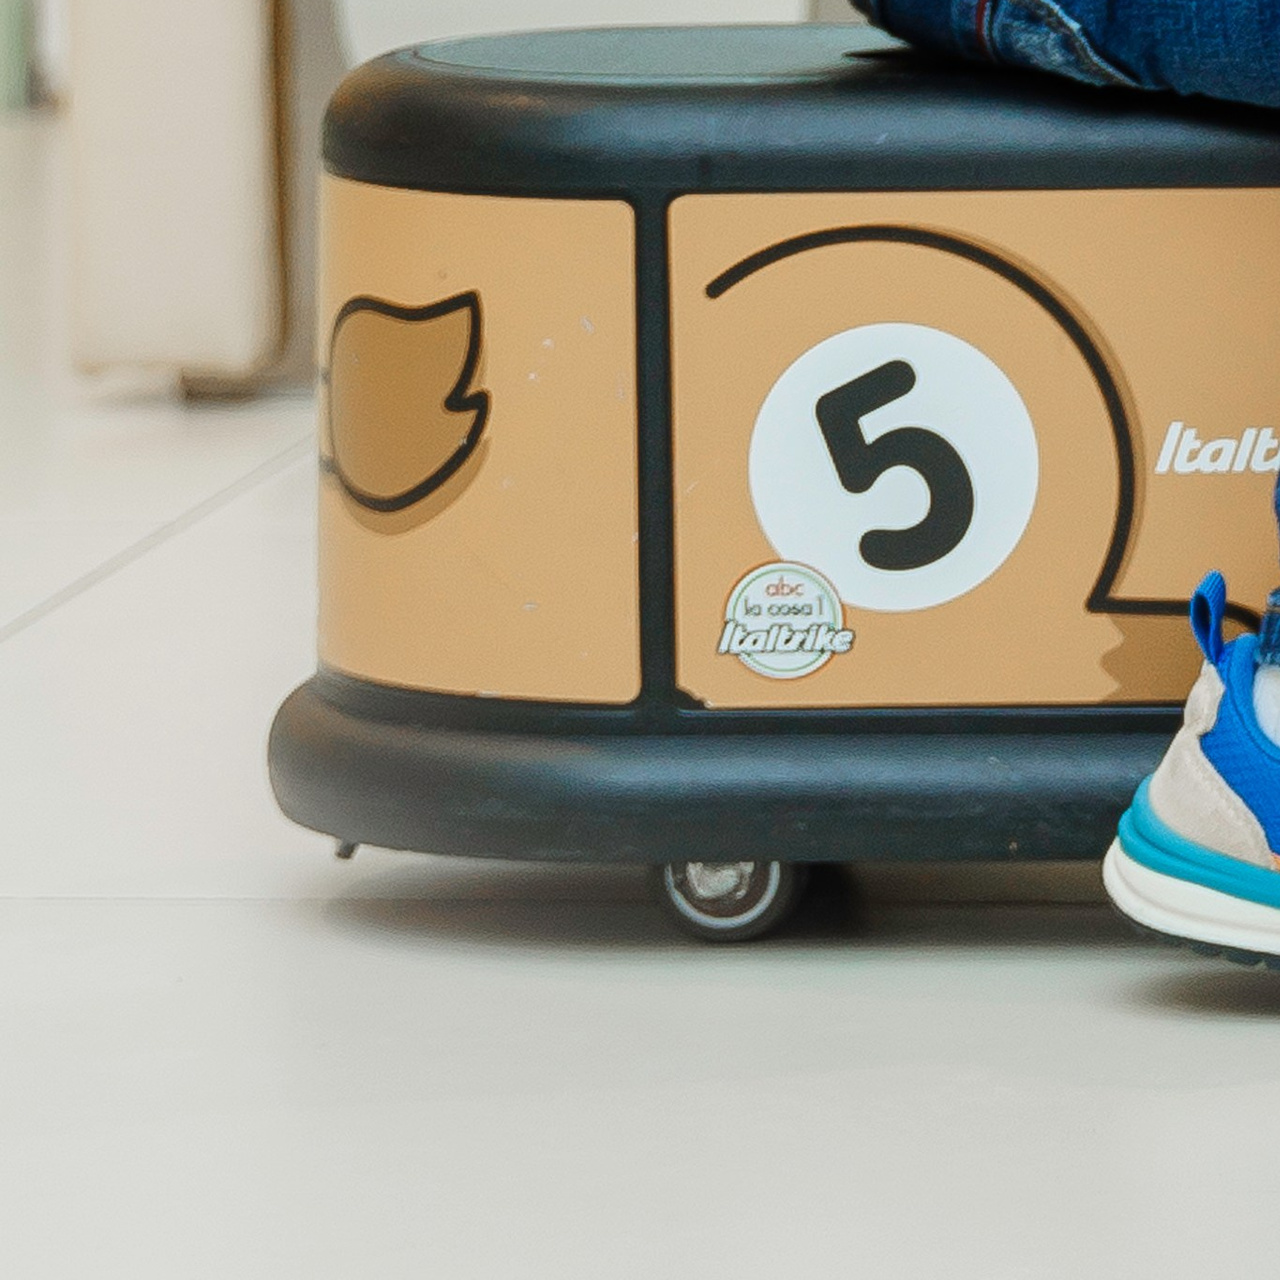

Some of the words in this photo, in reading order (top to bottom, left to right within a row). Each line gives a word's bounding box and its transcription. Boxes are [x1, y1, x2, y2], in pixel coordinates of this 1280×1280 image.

[815, 359, 975, 572] 5
[765, 575, 804, 597] abc
[767, 603, 813, 616] cosa
[717, 618, 855, 655] Italtrike
